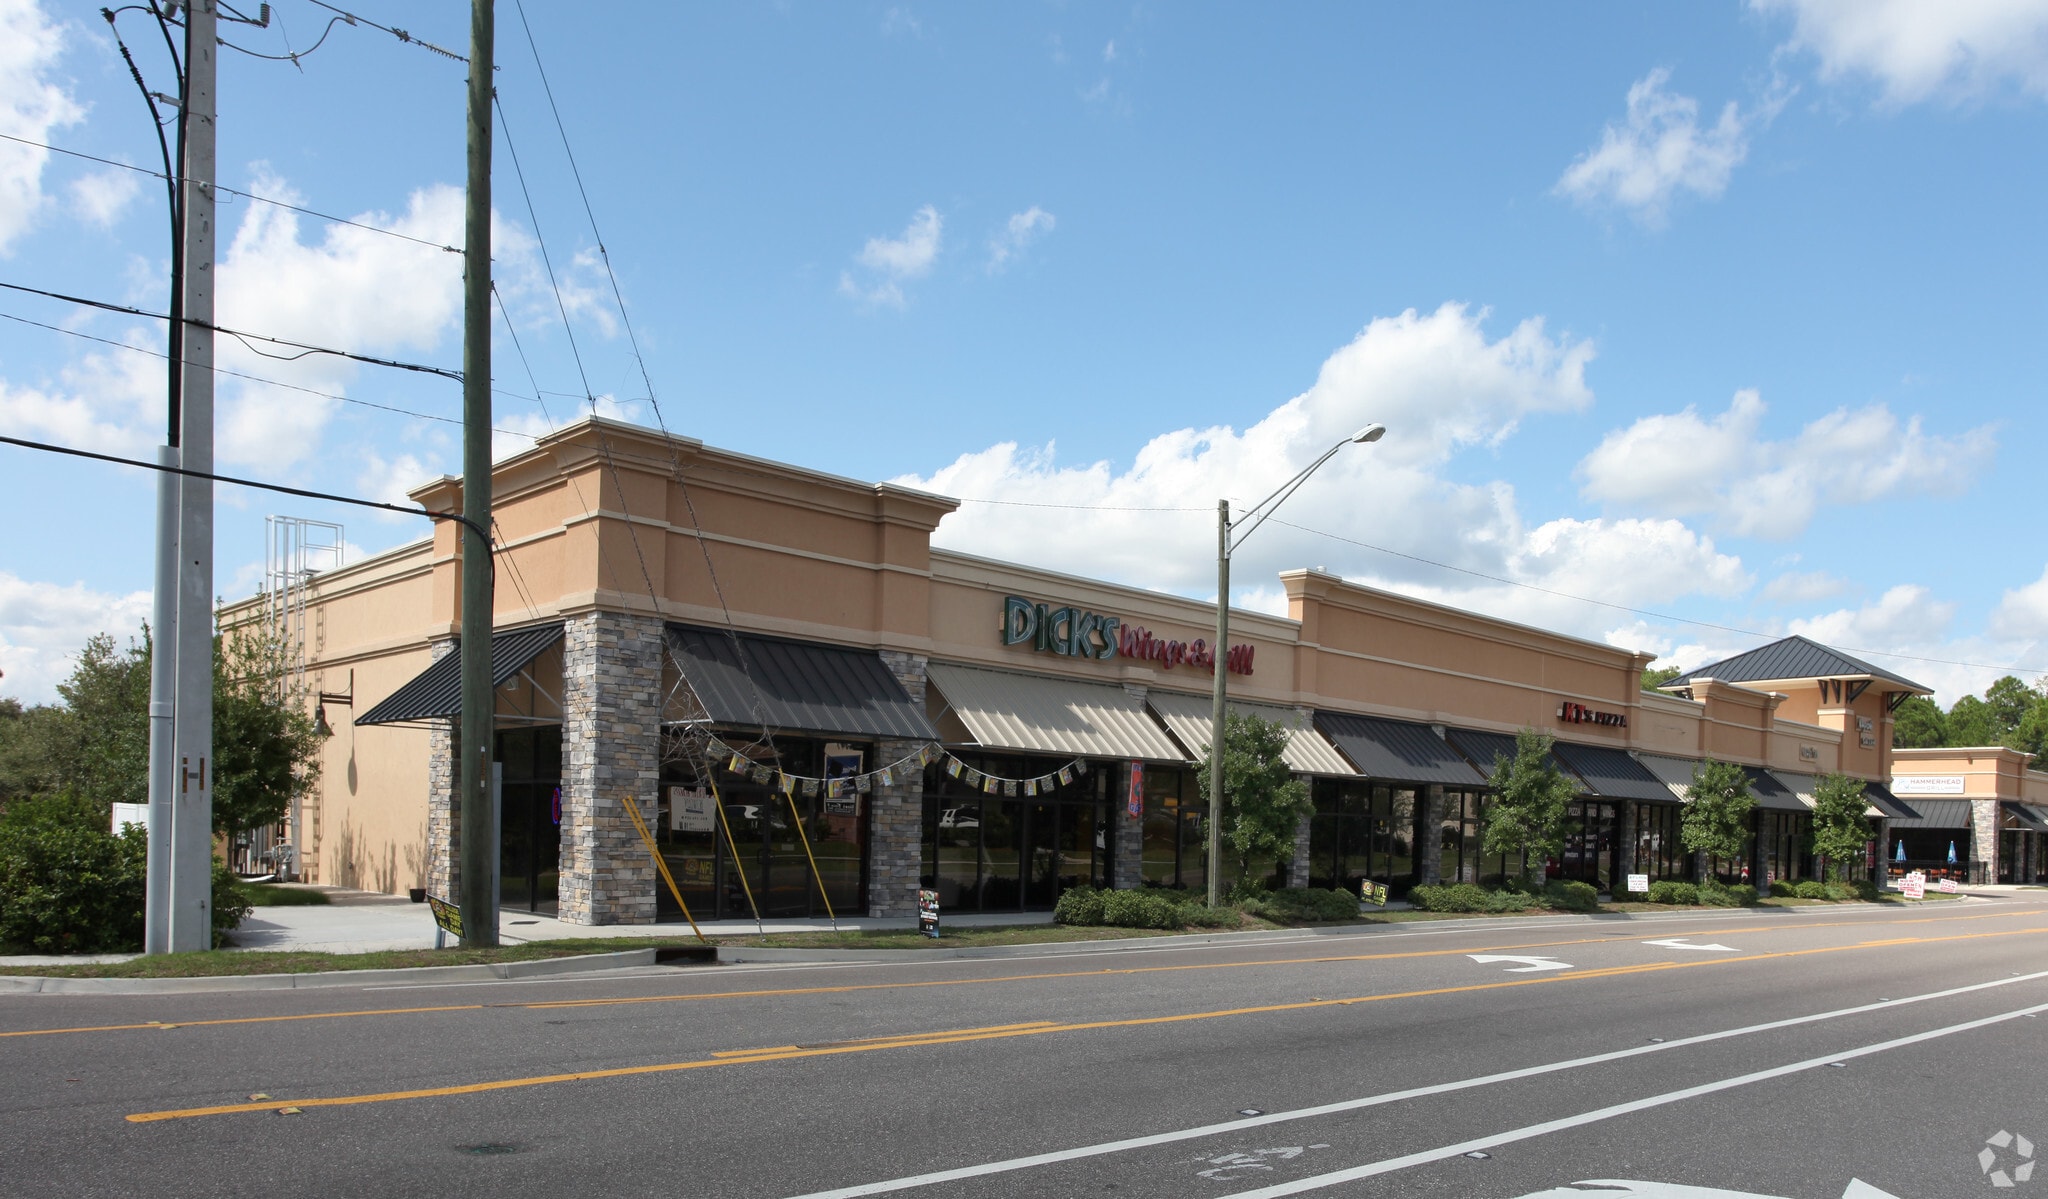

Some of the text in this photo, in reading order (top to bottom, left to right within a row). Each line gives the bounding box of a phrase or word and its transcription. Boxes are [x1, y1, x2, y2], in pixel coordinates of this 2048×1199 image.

[1003, 596, 1120, 660] DICK'S
[1119, 623, 1187, 670] Wings
[1187, 638, 1209, 667] &
[699, 861, 714, 874] NFL
[1374, 885, 1386, 898] NFL
